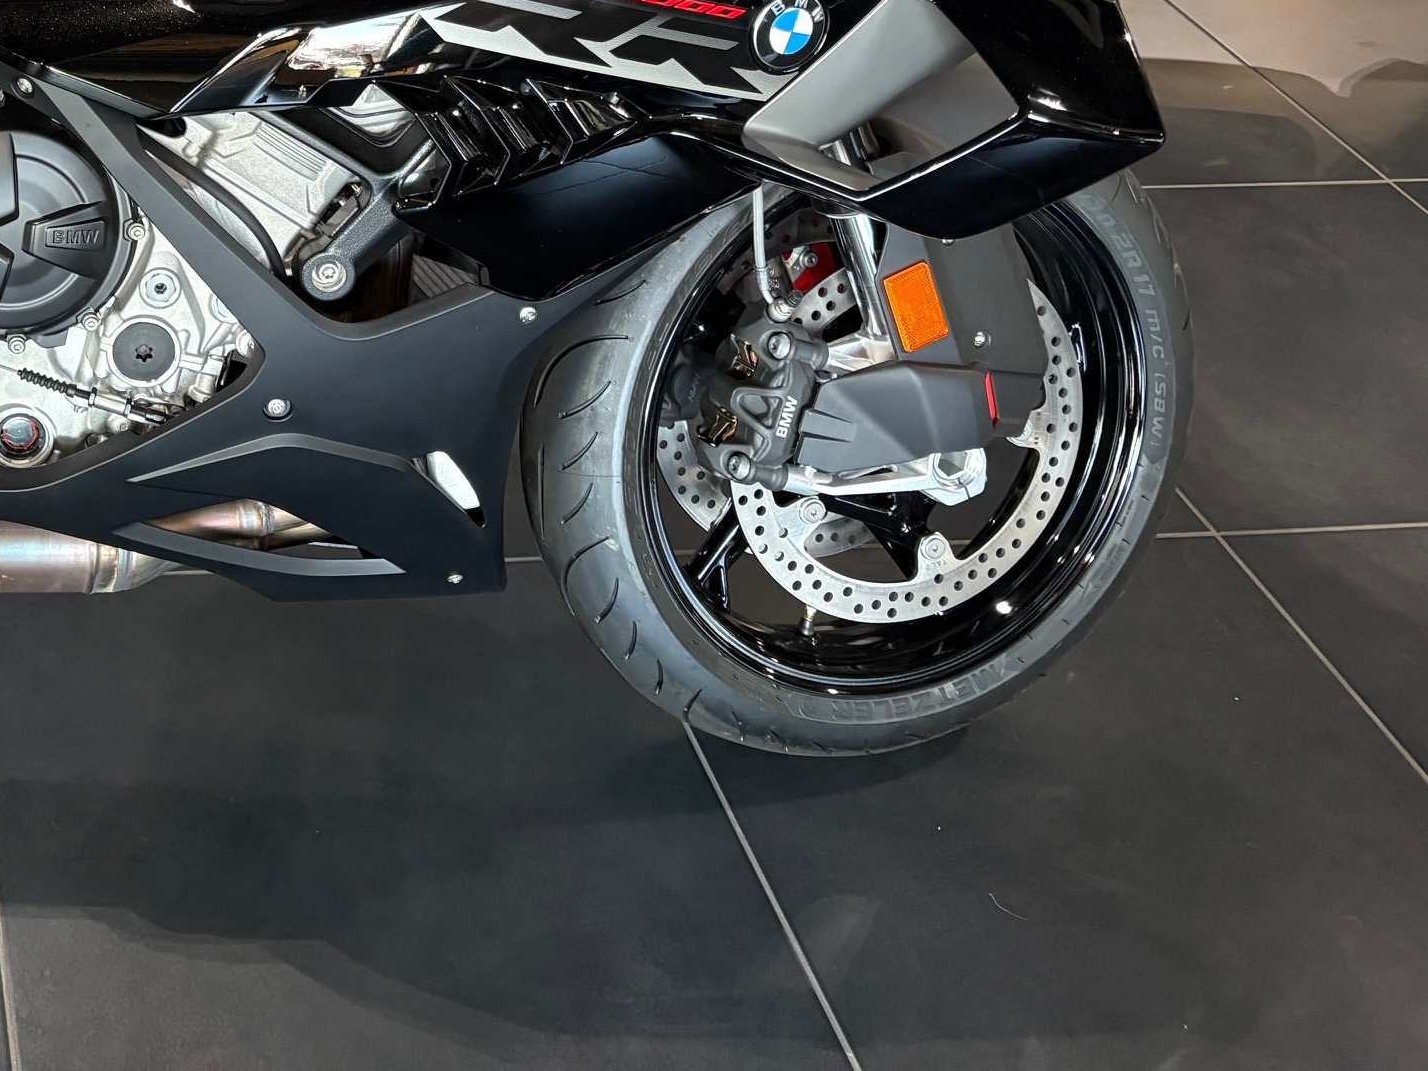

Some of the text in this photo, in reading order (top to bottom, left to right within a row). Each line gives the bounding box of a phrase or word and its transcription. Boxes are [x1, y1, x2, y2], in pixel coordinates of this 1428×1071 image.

[53, 229, 100, 245] BMW
[775, 395, 798, 439] BMW
[832, 662, 1006, 721] METZELER
